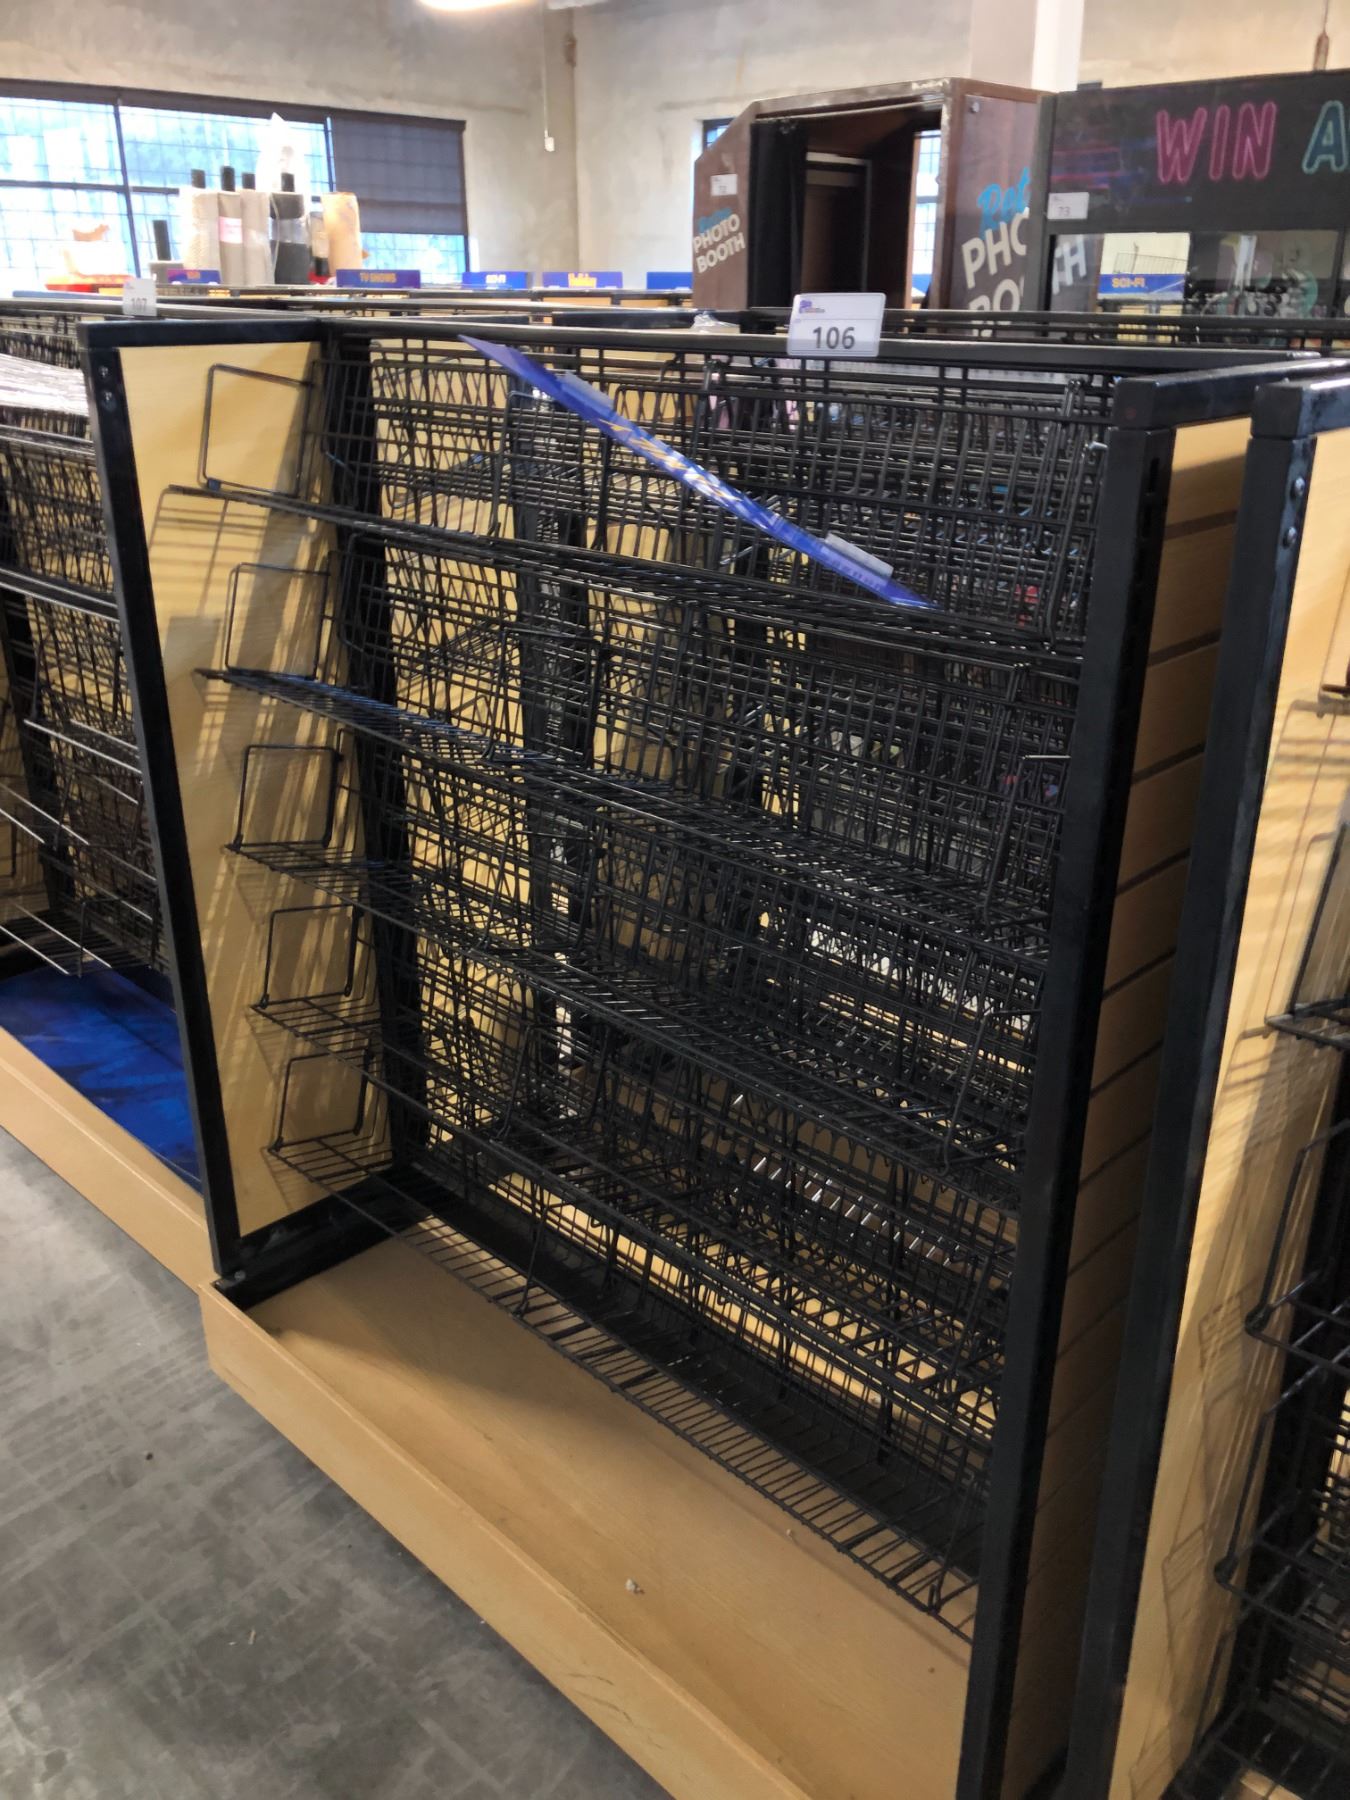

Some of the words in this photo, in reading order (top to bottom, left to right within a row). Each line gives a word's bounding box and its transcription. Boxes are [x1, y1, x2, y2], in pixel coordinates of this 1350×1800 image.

[1156, 101, 1277, 183] WIN
[1302, 99, 1350, 175] A
[977, 167, 1031, 241] Ret
[694, 213, 741, 254] PHOTO
[696, 232, 746, 273] BOOTH
[961, 206, 1030, 289] PHO
[1111, 277, 1146, 289] SCI-FI
[131, 297, 148, 312] 107
[813, 326, 856, 350] 106
